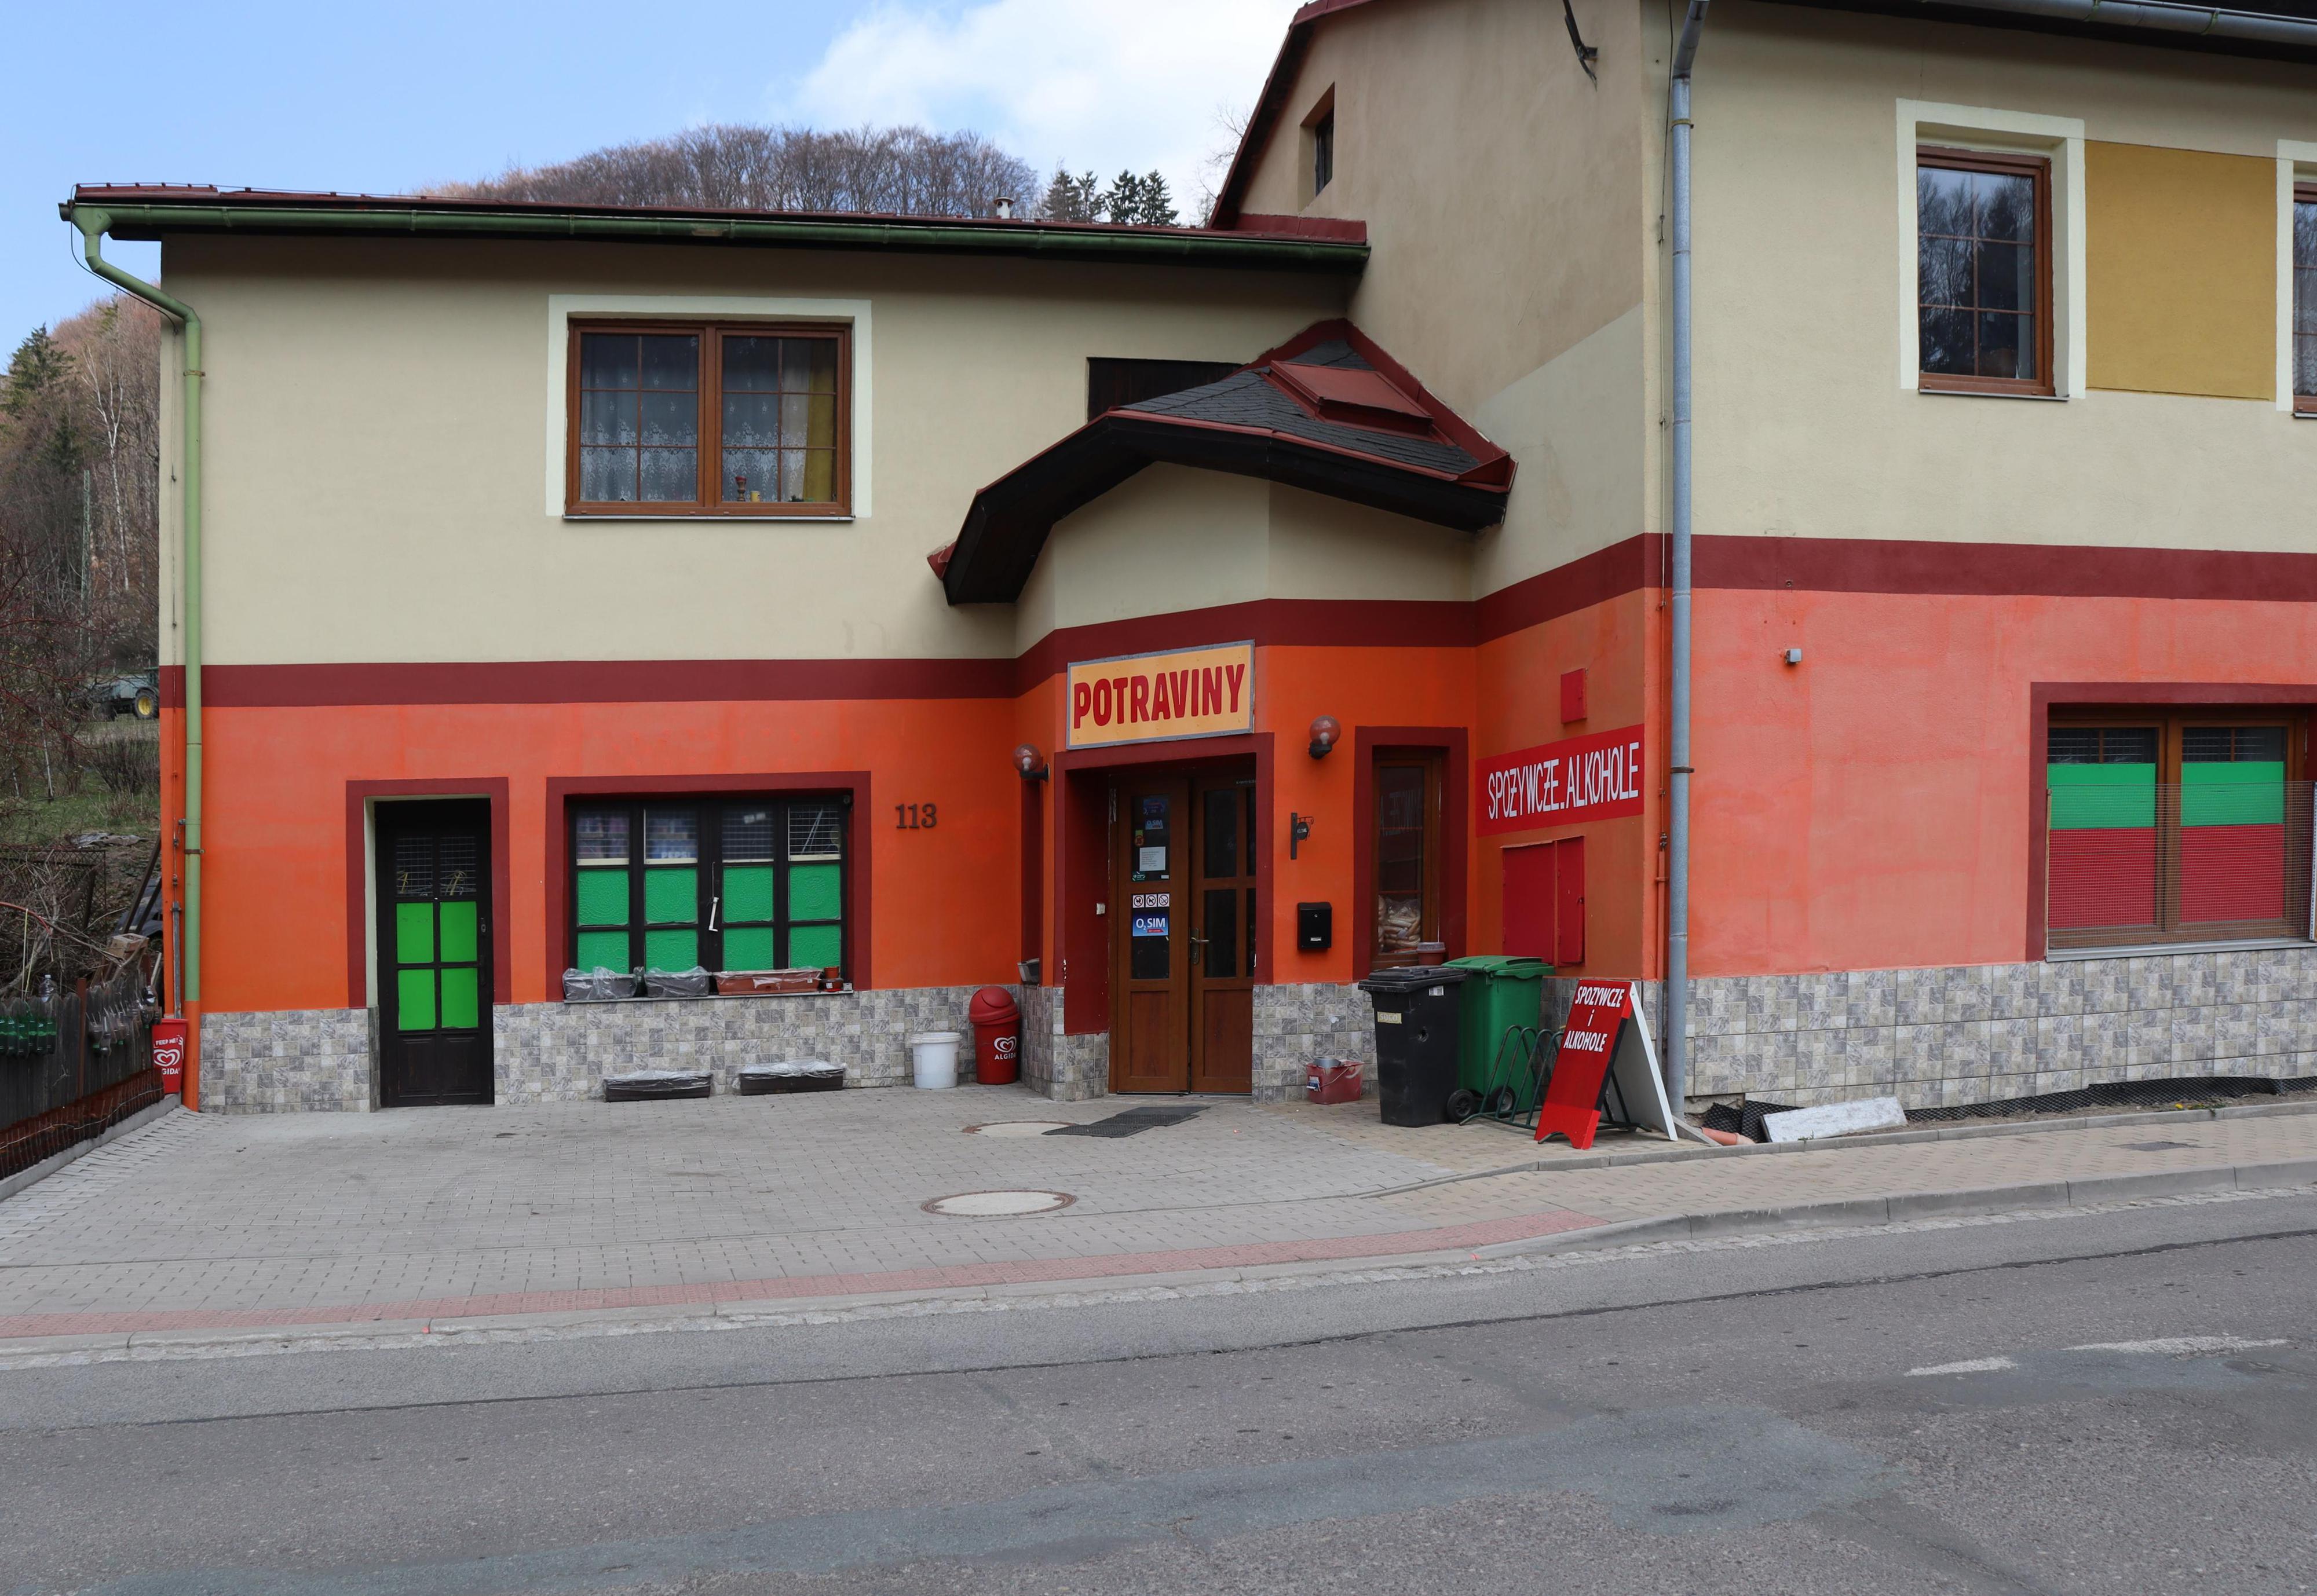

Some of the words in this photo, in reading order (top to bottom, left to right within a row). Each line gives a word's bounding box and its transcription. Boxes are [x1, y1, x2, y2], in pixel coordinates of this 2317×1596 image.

[1073, 663, 1245, 729] POTRAVINY
[895, 803, 937, 829] 113
[1147, 917, 1165, 928] SIM
[1587, 1009, 1595, 1027] i
[1563, 1030, 1608, 1052] ALKOHOLE
